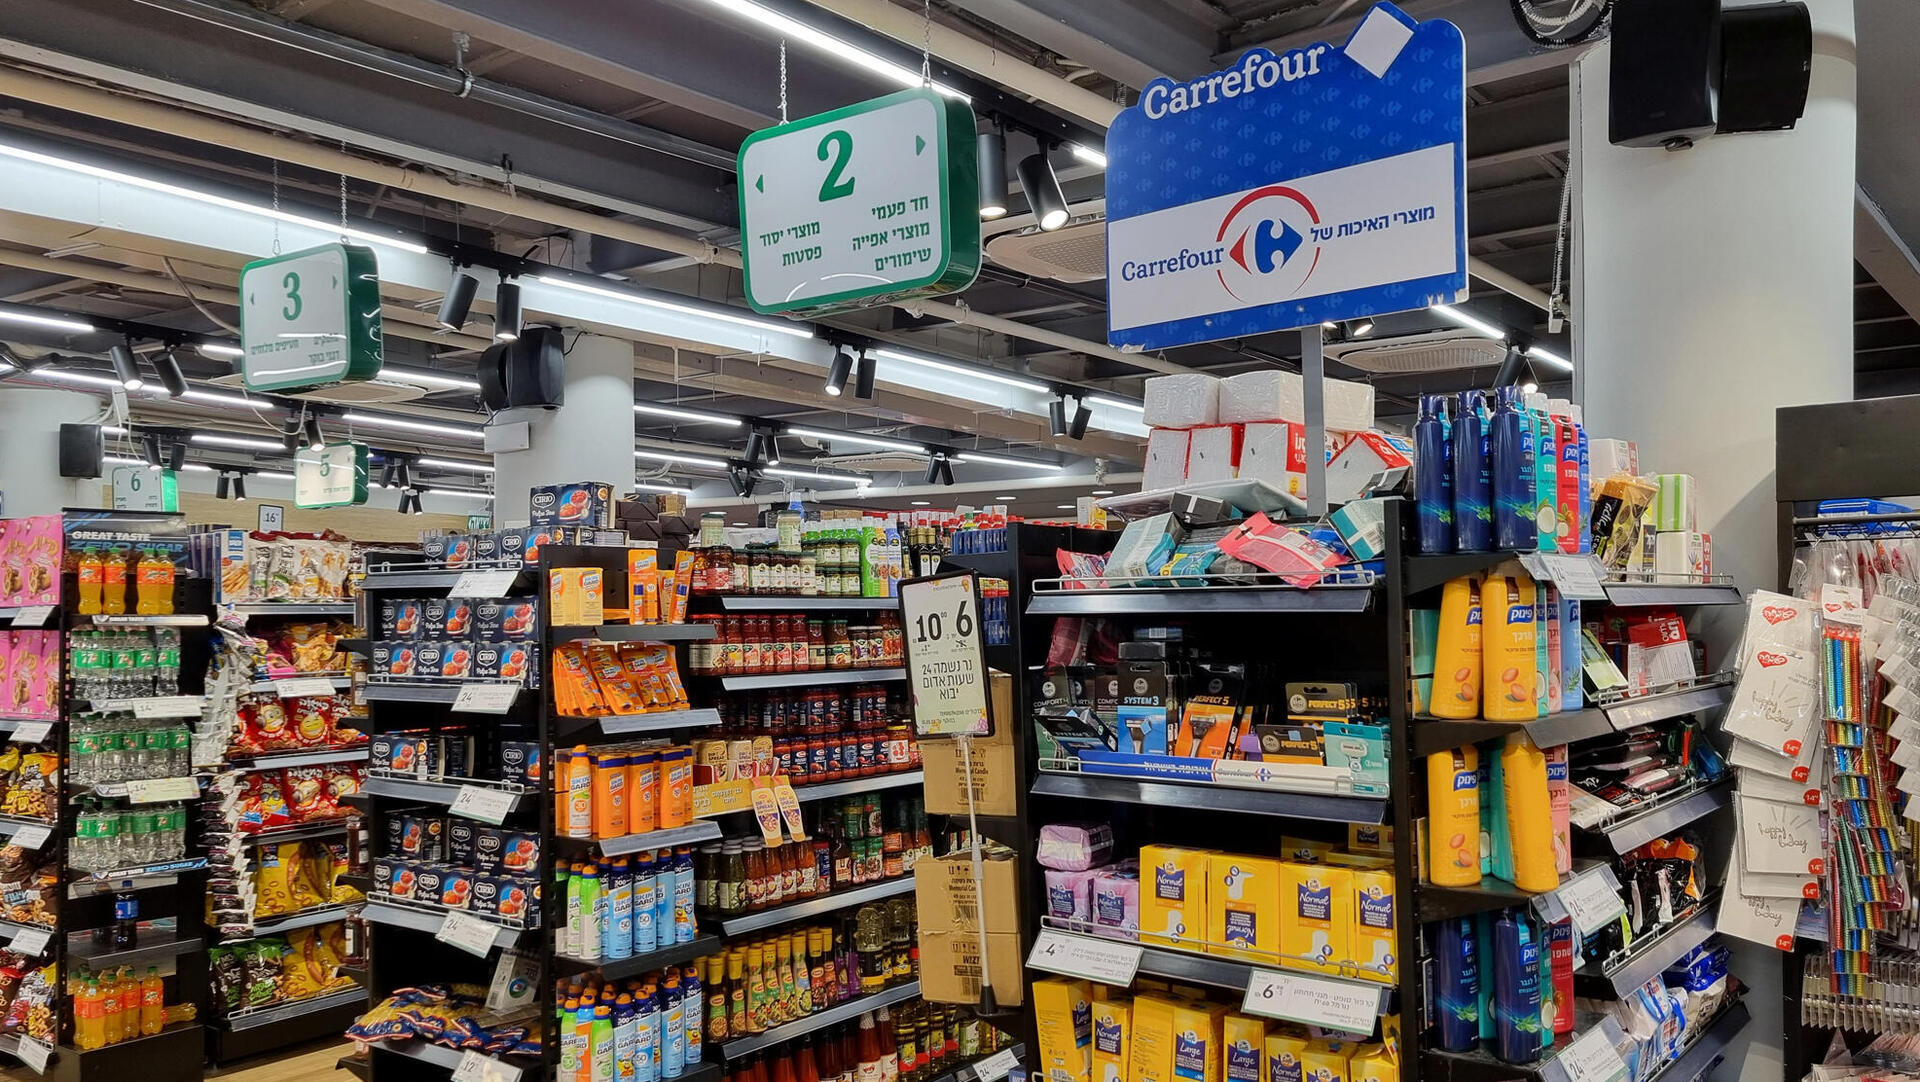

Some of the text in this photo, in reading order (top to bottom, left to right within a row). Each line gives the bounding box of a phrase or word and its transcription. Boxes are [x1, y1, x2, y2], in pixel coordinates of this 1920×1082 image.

[1144, 46, 1326, 119] Carrefour
[816, 130, 855, 201] 2
[871, 196, 929, 220] חד פעמי
[1309, 205, 1435, 243] מוצרי האיכות של
[760, 221, 820, 247] מוצרי יסוד
[852, 222, 930, 251] מוצרי אפייה
[782, 246, 822, 267] פסטות
[874, 248, 931, 271] שימורים
[1121, 245, 1225, 281] Carrefour
[283, 272, 302, 320] 3
[319, 454, 330, 477] 5
[131, 471, 141, 491] 6
[534, 495, 553, 503] CIRIO
[265, 513, 276, 523] 16
[72, 531, 151, 541] GREAT TASTE
[503, 538, 520, 546] CIRIO
[135, 542, 184, 552] SUGAR
[426, 545, 443, 553] CIRIO
[916, 600, 973, 642] 10 6
[420, 652, 439, 660] CIRIO
[922, 659, 973, 675] נר נשמה 24
[923, 673, 974, 689] שעות אדום
[939, 688, 959, 700] יבוא
[1195, 696, 1230, 705] PERFECT 5
[1124, 696, 1159, 706] SYSTEM 3
[1308, 699, 1345, 710] PERFECT 5
[1281, 740, 1318, 750] PERFECT 5
[571, 776, 590, 784] SKIN
[571, 782, 590, 790] GARD
[460, 793, 472, 804] 24
[1758, 823, 1787, 840] happy
[480, 838, 499, 847] CIRIO
[420, 877, 439, 886] CIRIO
[1157, 874, 1183, 887] Normal
[476, 886, 495, 894] CIRIO
[635, 897, 654, 906] GARD
[1300, 892, 1330, 905] Normal
[1361, 900, 1392, 913] Normal
[620, 921, 631, 929] 50
[639, 915, 650, 923] 50
[1227, 924, 1254, 937] Normal
[1045, 943, 1055, 956] 4
[1552, 948, 1571, 959] שמפו
[1263, 984, 1274, 999] 6
[1096, 1027, 1120, 1041] Normal
[1180, 1043, 1201, 1057] Large
[1232, 1052, 1255, 1066] Large
[463, 1060, 475, 1072] 12
[1272, 1065, 1300, 1078] Normal
[1569, 1061, 1585, 1080] 24
